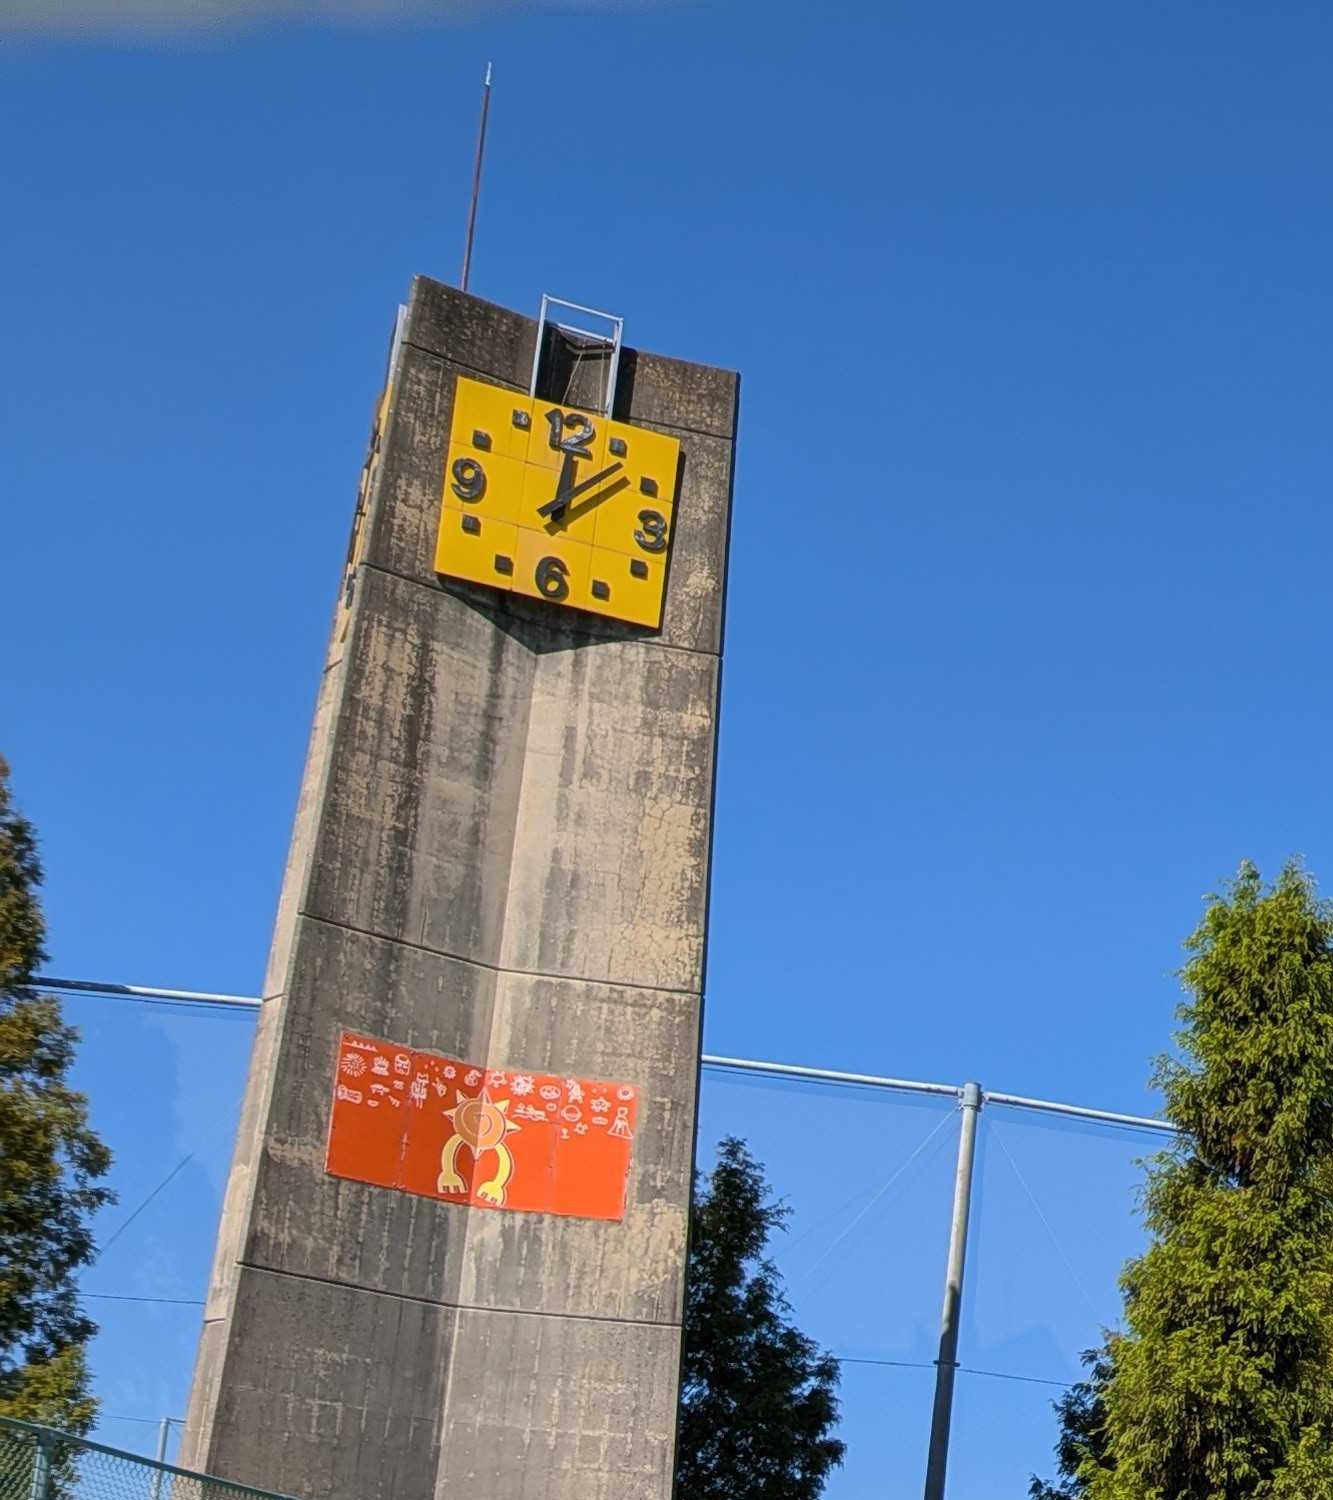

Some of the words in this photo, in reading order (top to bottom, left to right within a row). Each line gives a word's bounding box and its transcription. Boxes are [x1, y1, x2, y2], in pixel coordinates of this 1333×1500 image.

[545, 409, 593, 458] 12
[451, 457, 487, 502] 9
[634, 510, 668, 553] 3
[535, 556, 570, 598] 6
